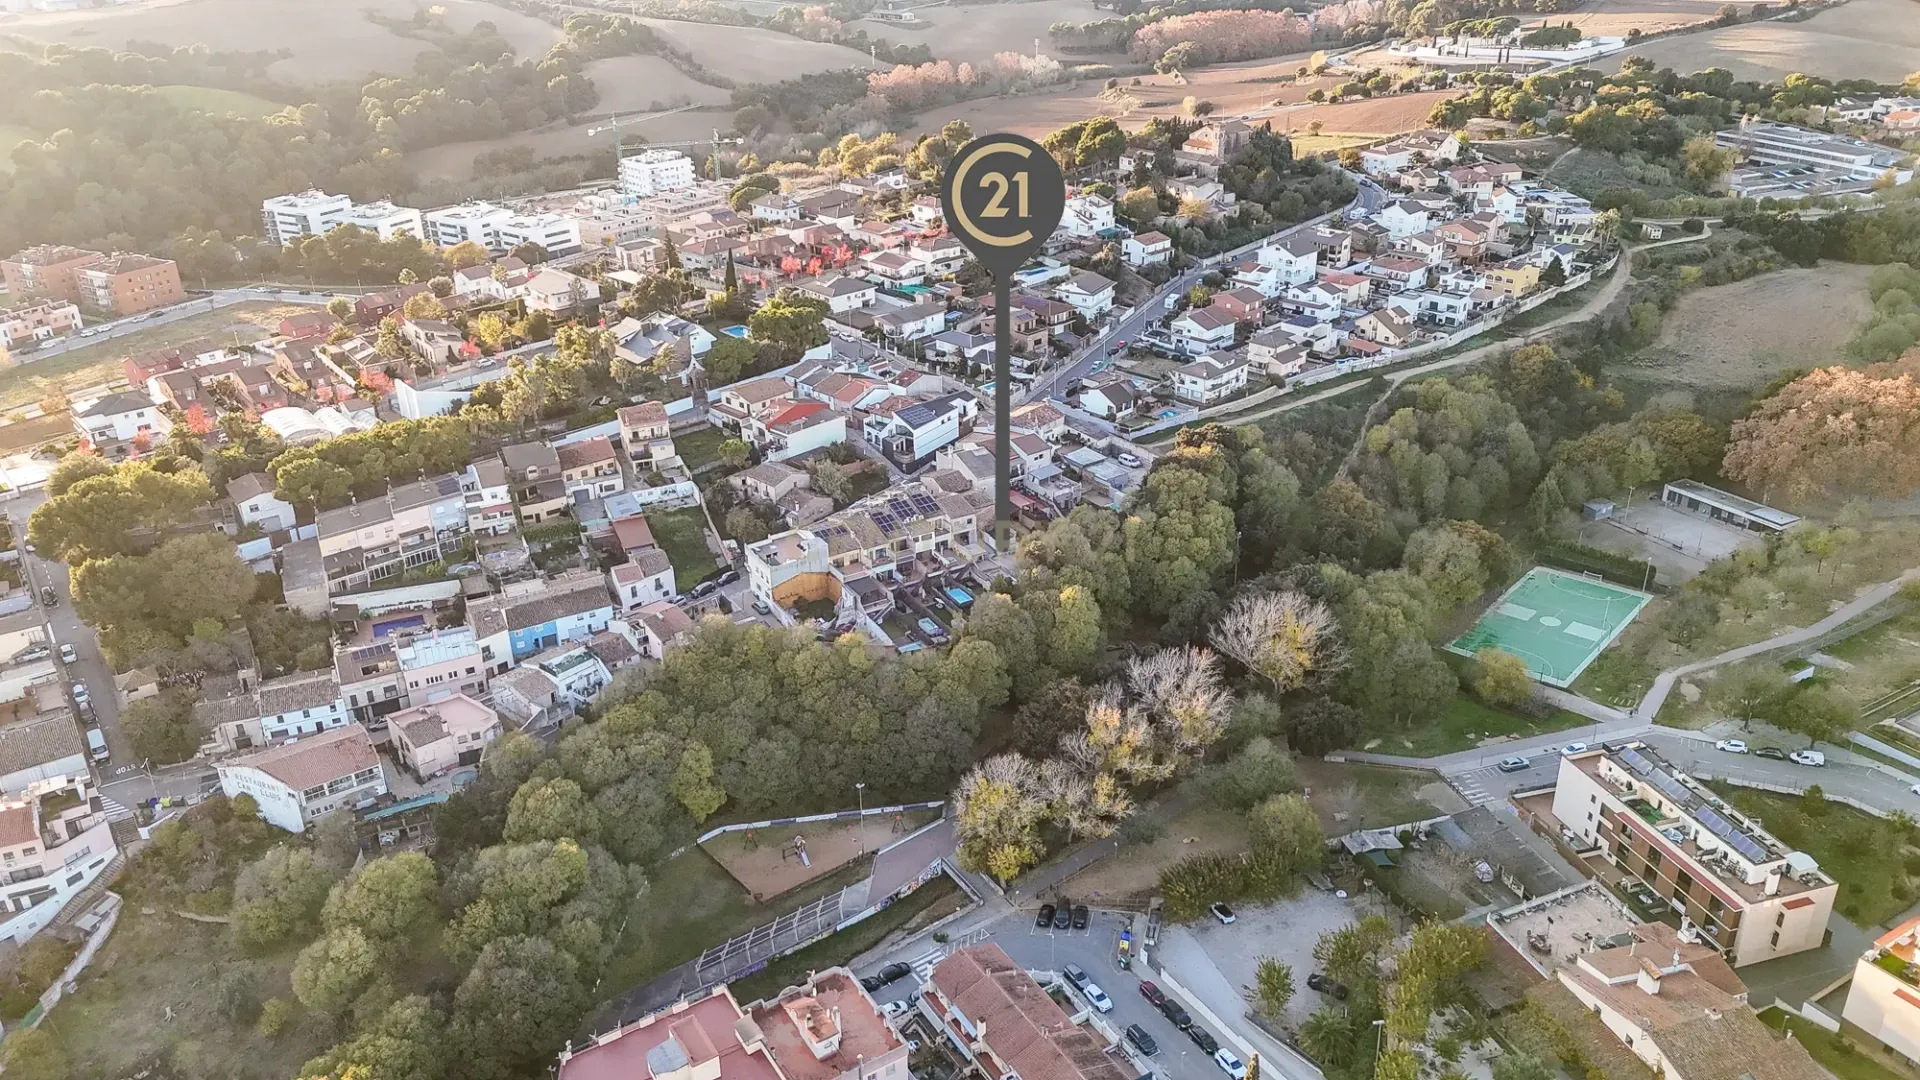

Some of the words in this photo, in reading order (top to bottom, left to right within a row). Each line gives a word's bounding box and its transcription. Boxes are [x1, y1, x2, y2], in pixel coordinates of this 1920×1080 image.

[115, 763, 136, 775] STOP
[234, 773, 280, 792] RESTAURANT
[237, 781, 252, 792] CAN
